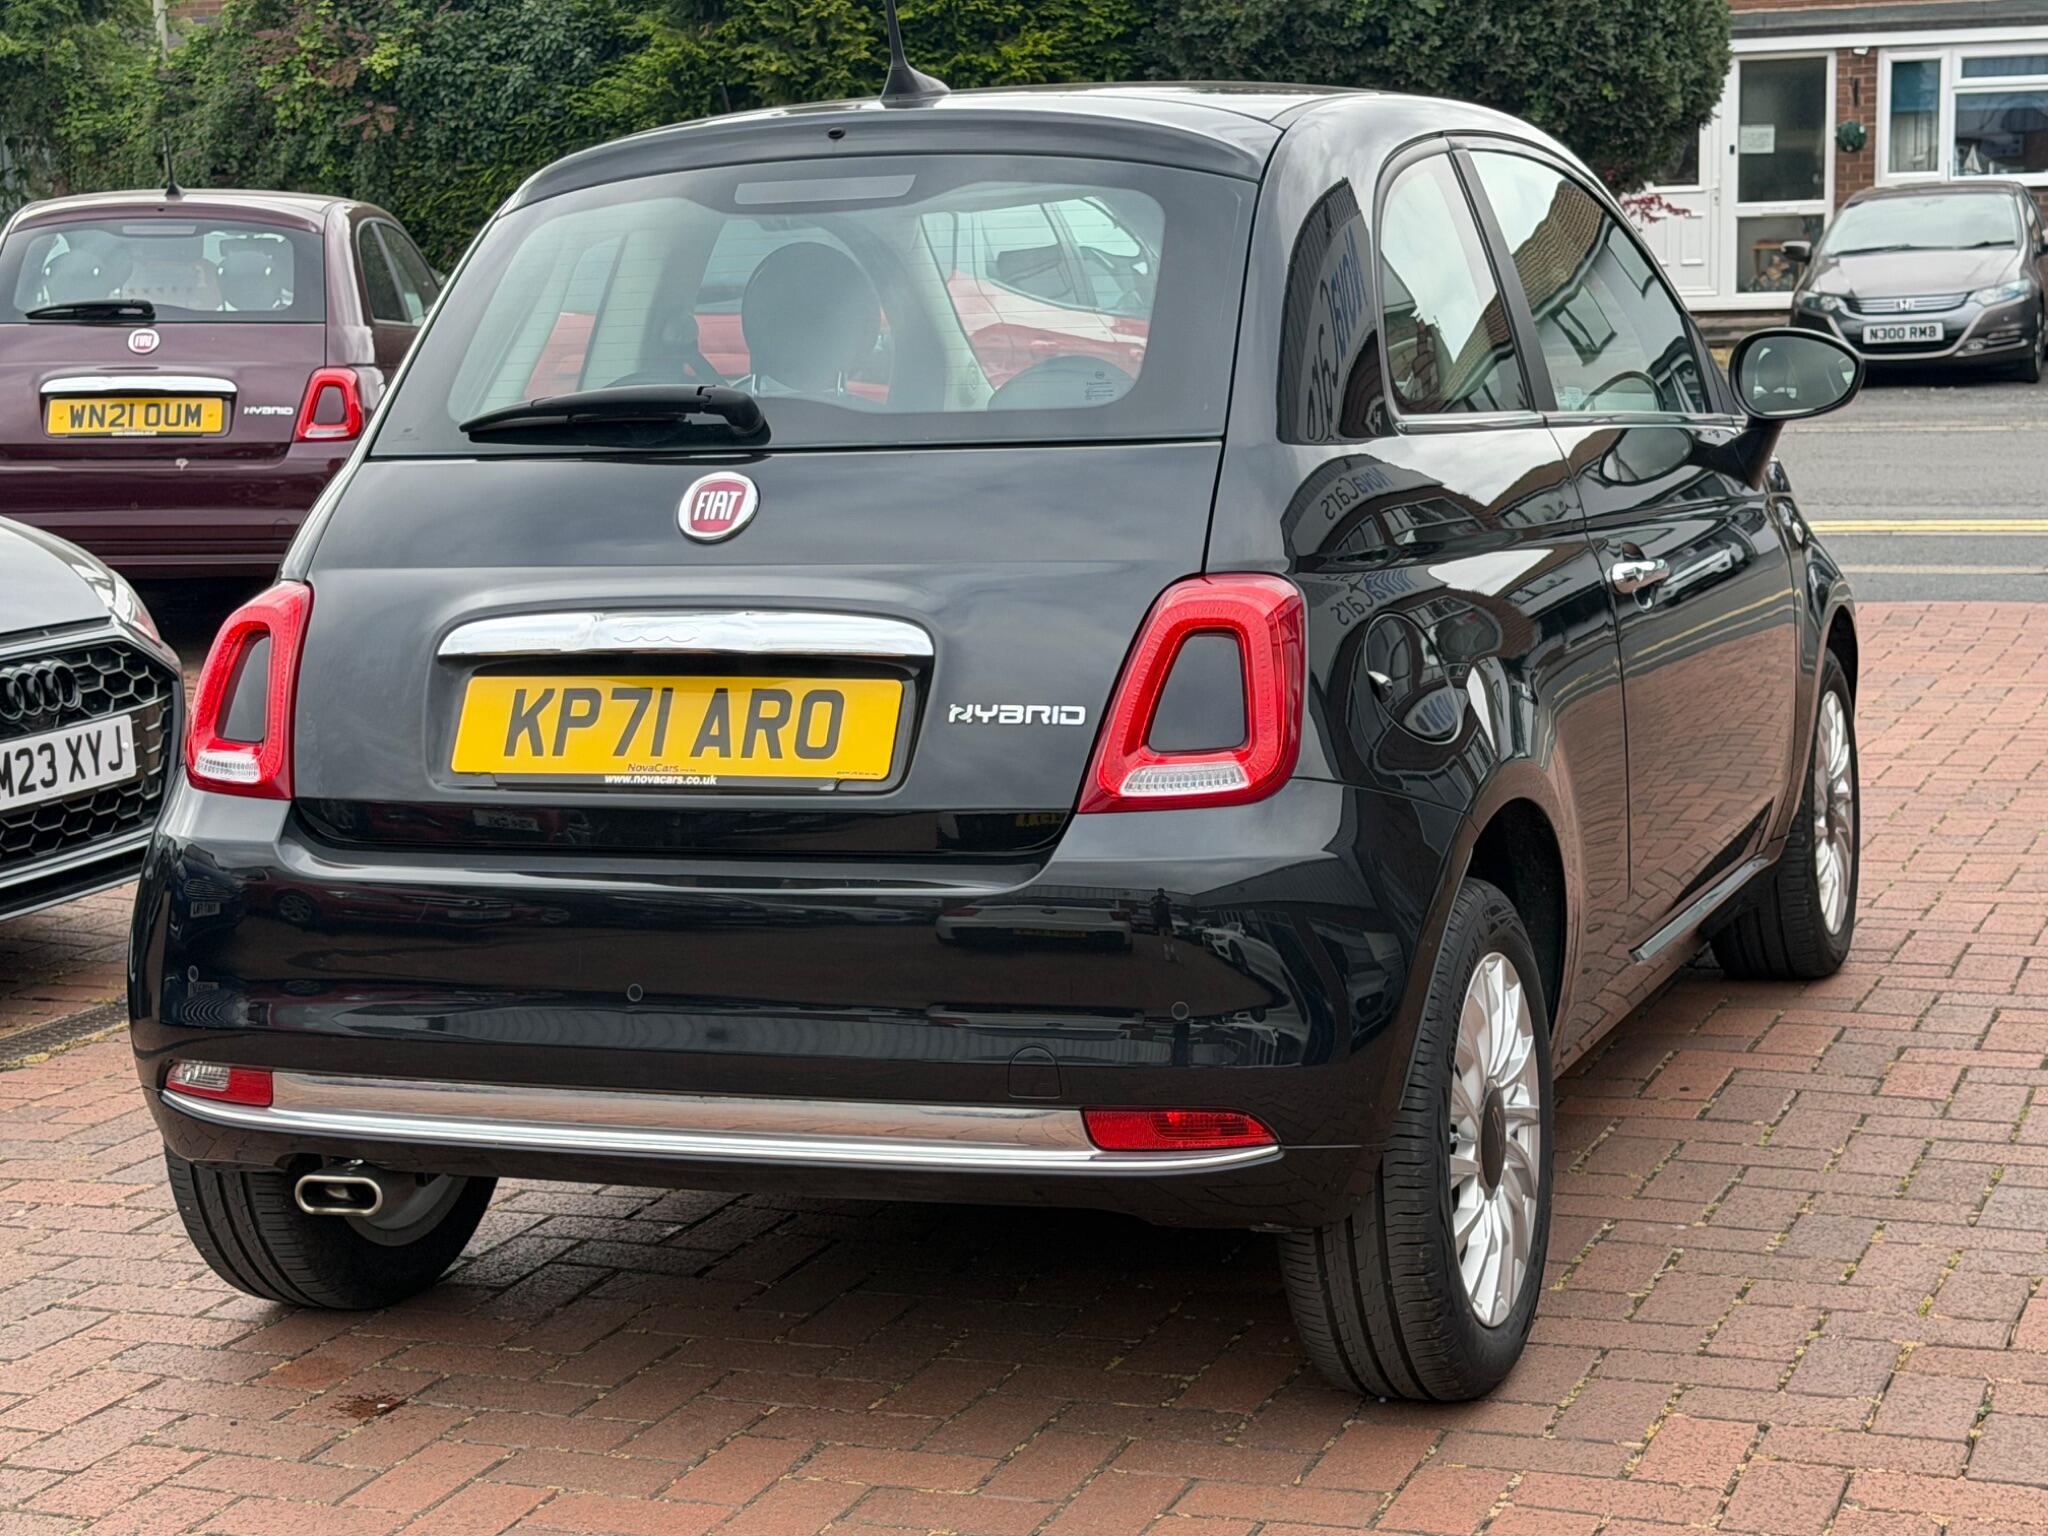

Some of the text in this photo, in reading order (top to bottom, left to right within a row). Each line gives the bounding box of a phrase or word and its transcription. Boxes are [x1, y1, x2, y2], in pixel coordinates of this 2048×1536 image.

[1869, 326, 1906, 341] N300
[69, 403, 203, 428] WN21 OUM
[693, 490, 743, 521] FIAT
[503, 687, 846, 760] KP71 ARO
[948, 704, 1087, 725] HYBRID
[0, 725, 124, 798] M23 XYJ
[627, 763, 680, 773] NovaCars
[603, 774, 718, 785] www.novacars.co.uk
